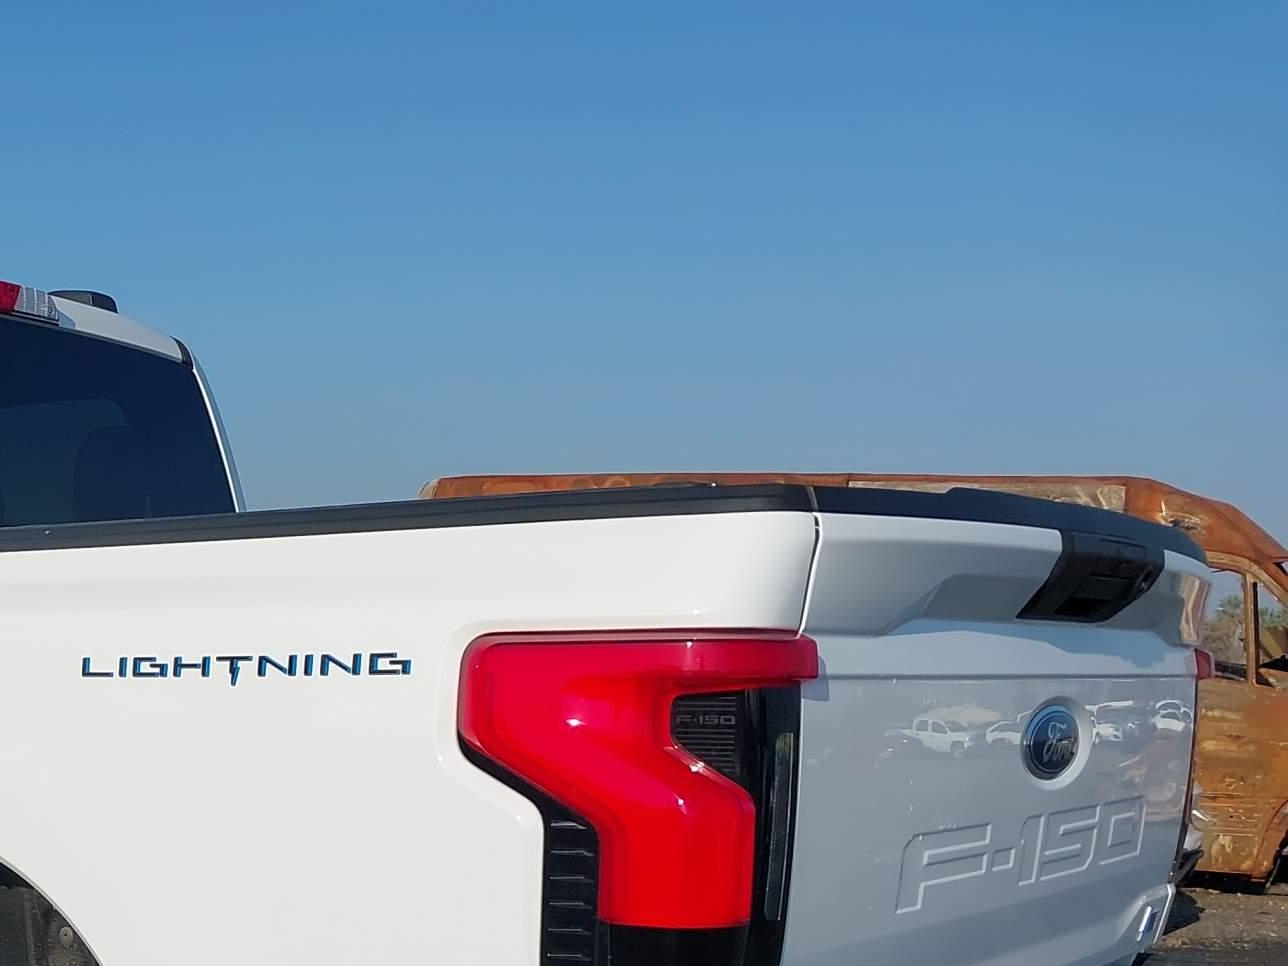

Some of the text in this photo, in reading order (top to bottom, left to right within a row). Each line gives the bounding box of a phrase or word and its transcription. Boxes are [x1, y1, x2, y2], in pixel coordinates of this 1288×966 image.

[81, 652, 412, 686] LIGHTNING
[675, 714, 737, 726] F-150
[895, 795, 1145, 914] F-150
